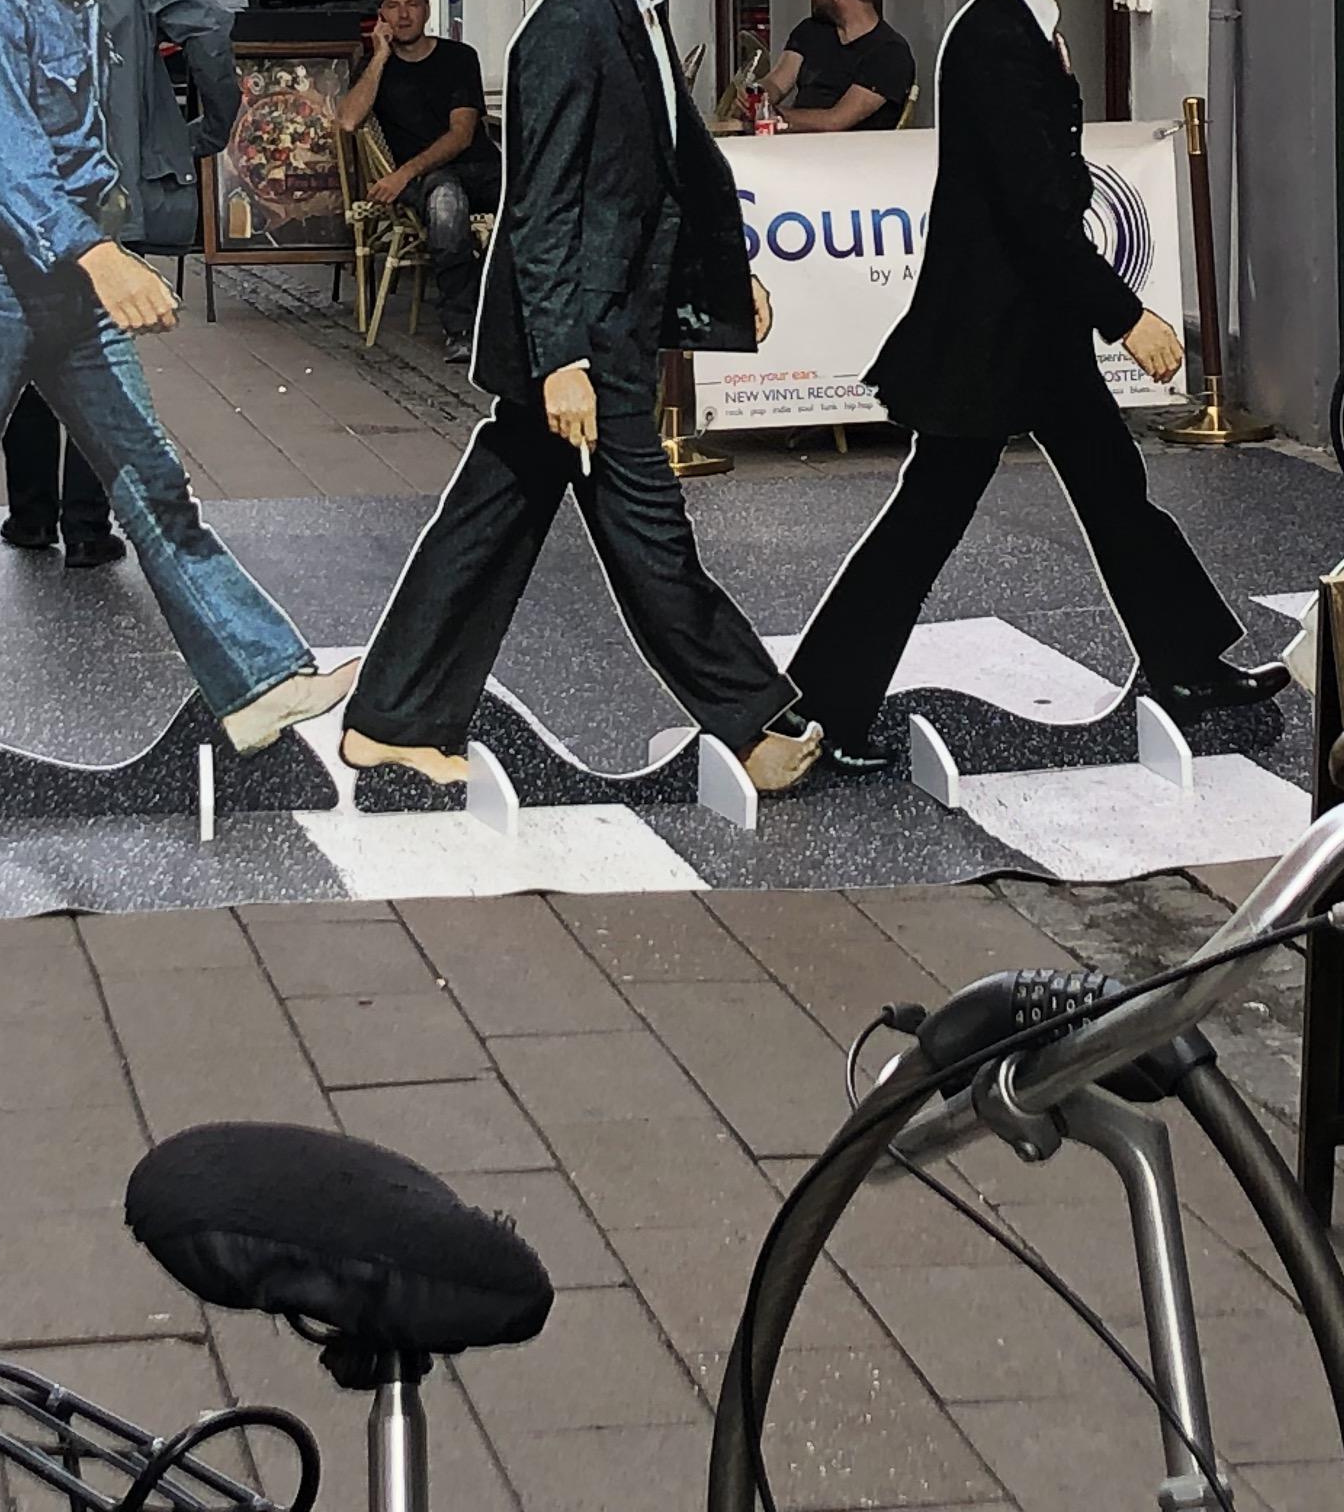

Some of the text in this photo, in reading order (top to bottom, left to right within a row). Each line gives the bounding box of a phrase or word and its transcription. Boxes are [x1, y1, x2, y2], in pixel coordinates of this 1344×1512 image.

[736, 189, 927, 261] Soun
[869, 264, 892, 286] by
[724, 372, 756, 387] open
[759, 371, 789, 385] your
[725, 391, 760, 404] NEW
[763, 388, 805, 402] VINYL
